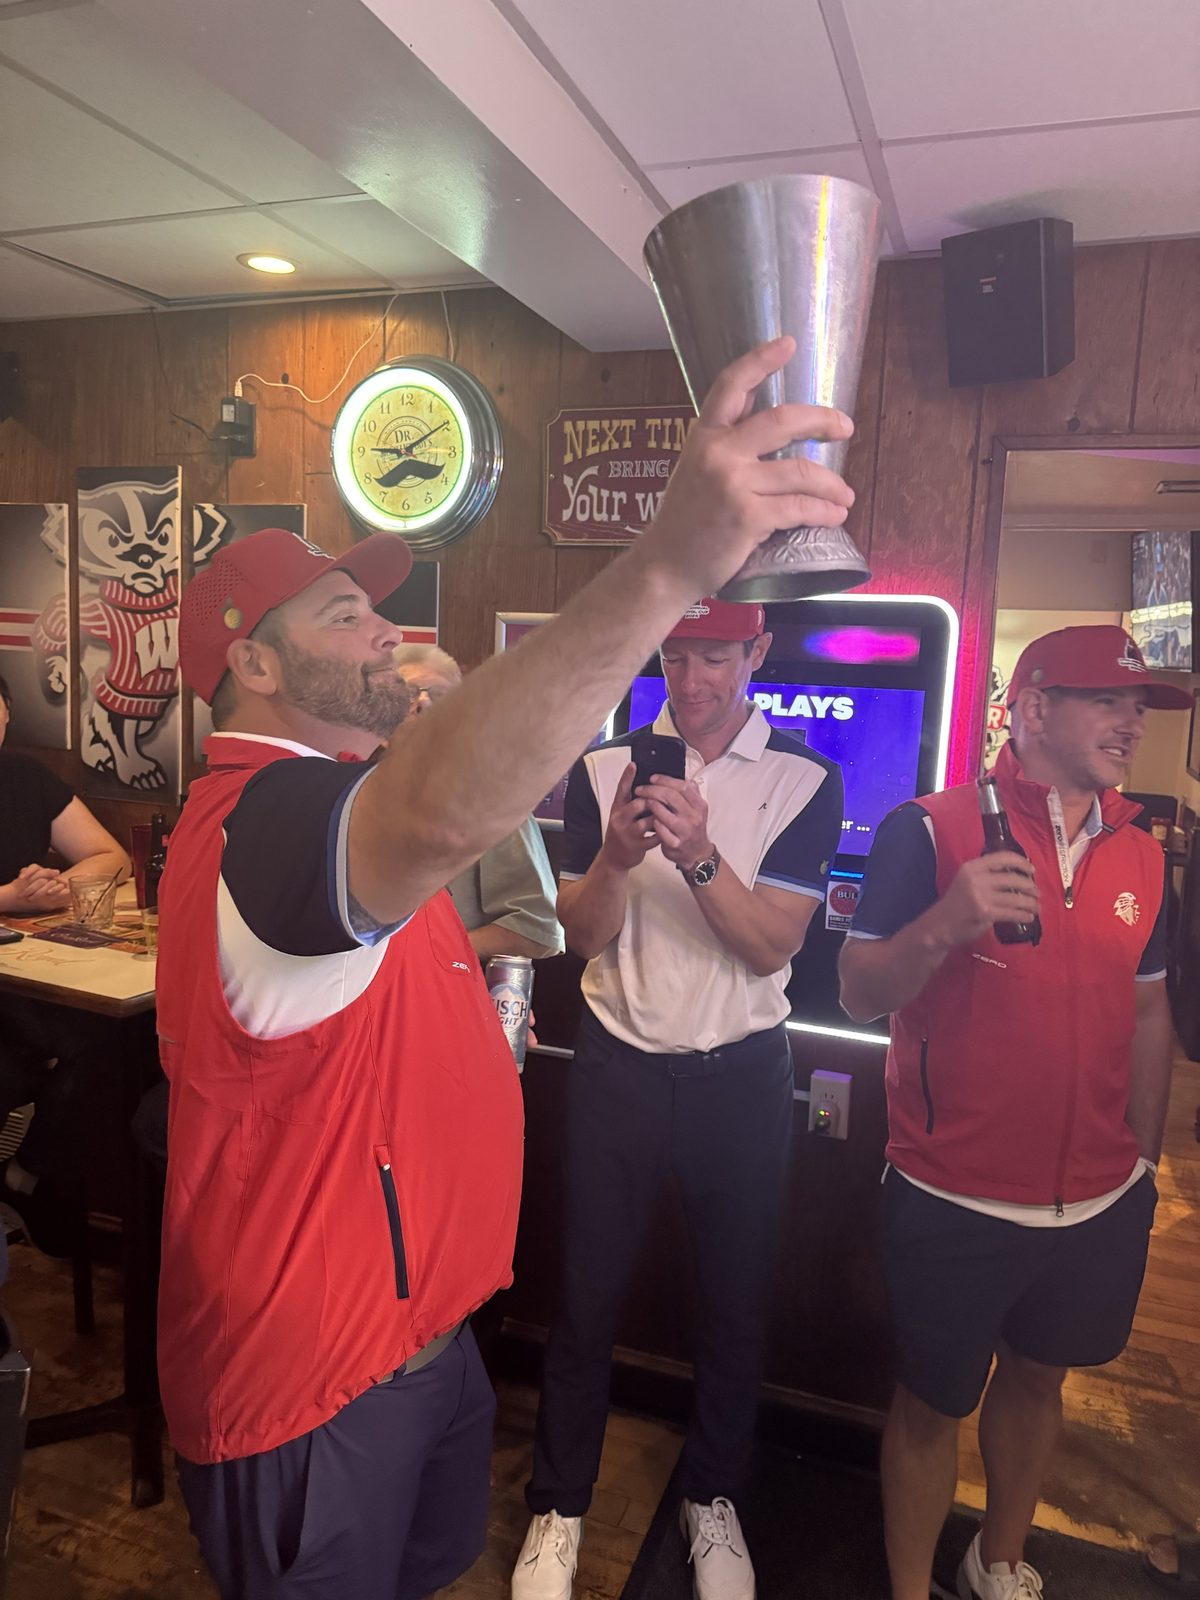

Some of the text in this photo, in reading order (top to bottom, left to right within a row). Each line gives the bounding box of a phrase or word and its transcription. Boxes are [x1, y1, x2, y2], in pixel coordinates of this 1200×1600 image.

[401, 393, 415, 406] 12
[380, 402, 391, 414] 11
[363, 420, 377, 432] 10
[394, 430, 414, 444] DR.
[563, 419, 636, 465] NEXT
[357, 447, 366, 457] 9
[447, 446, 457, 458] 3
[608, 459, 670, 478] BRING
[364, 473, 372, 484] 8
[441, 473, 449, 485] 4
[379, 491, 389, 503] 7
[424, 492, 433, 504] 5
[562, 465, 627, 522] Your
[401, 499, 410, 511] 6
[753, 692, 854, 721] PLAYS
